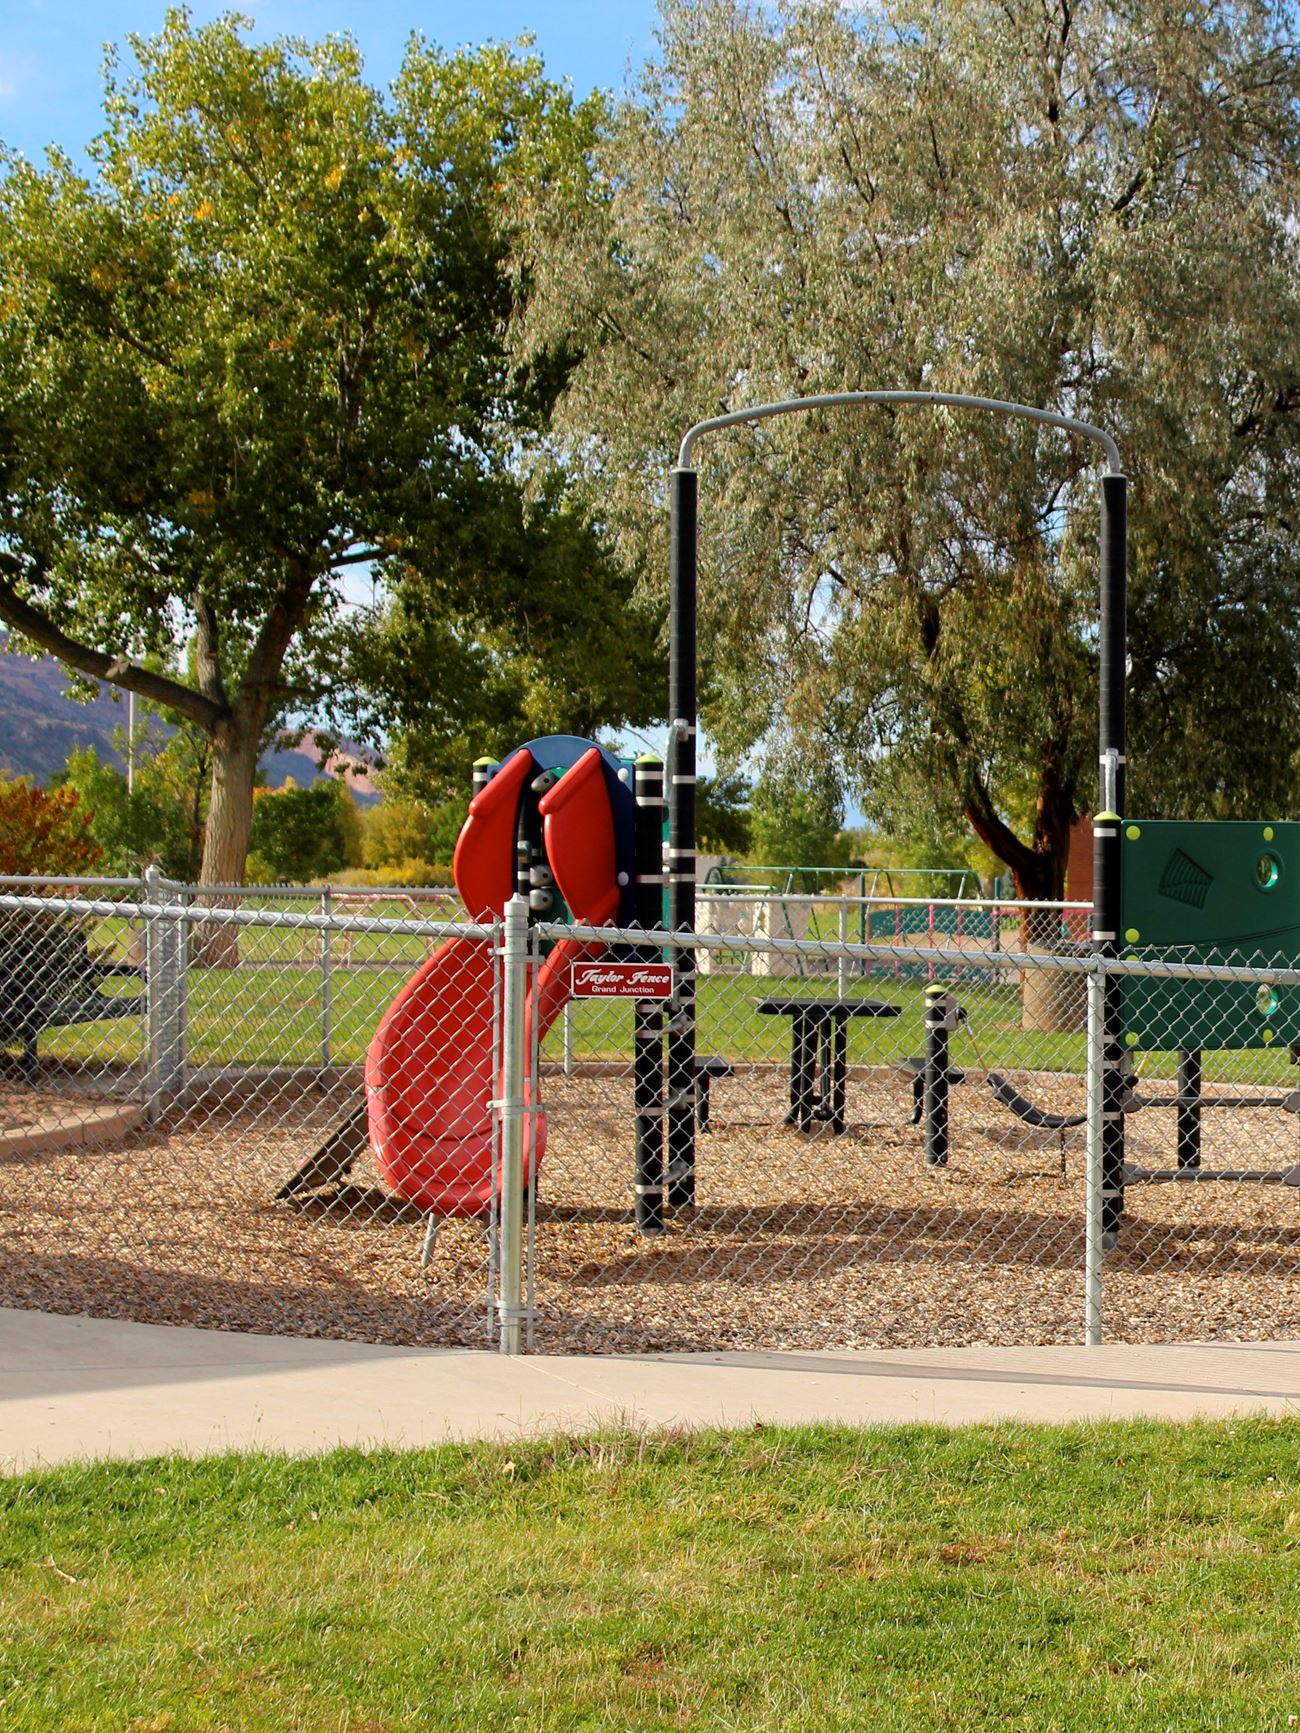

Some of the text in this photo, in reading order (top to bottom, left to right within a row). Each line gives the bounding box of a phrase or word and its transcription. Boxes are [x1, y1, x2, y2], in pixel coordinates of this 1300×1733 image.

[575, 968, 670, 985] Taylor Fence
[591, 985, 655, 994] Grand Junction
